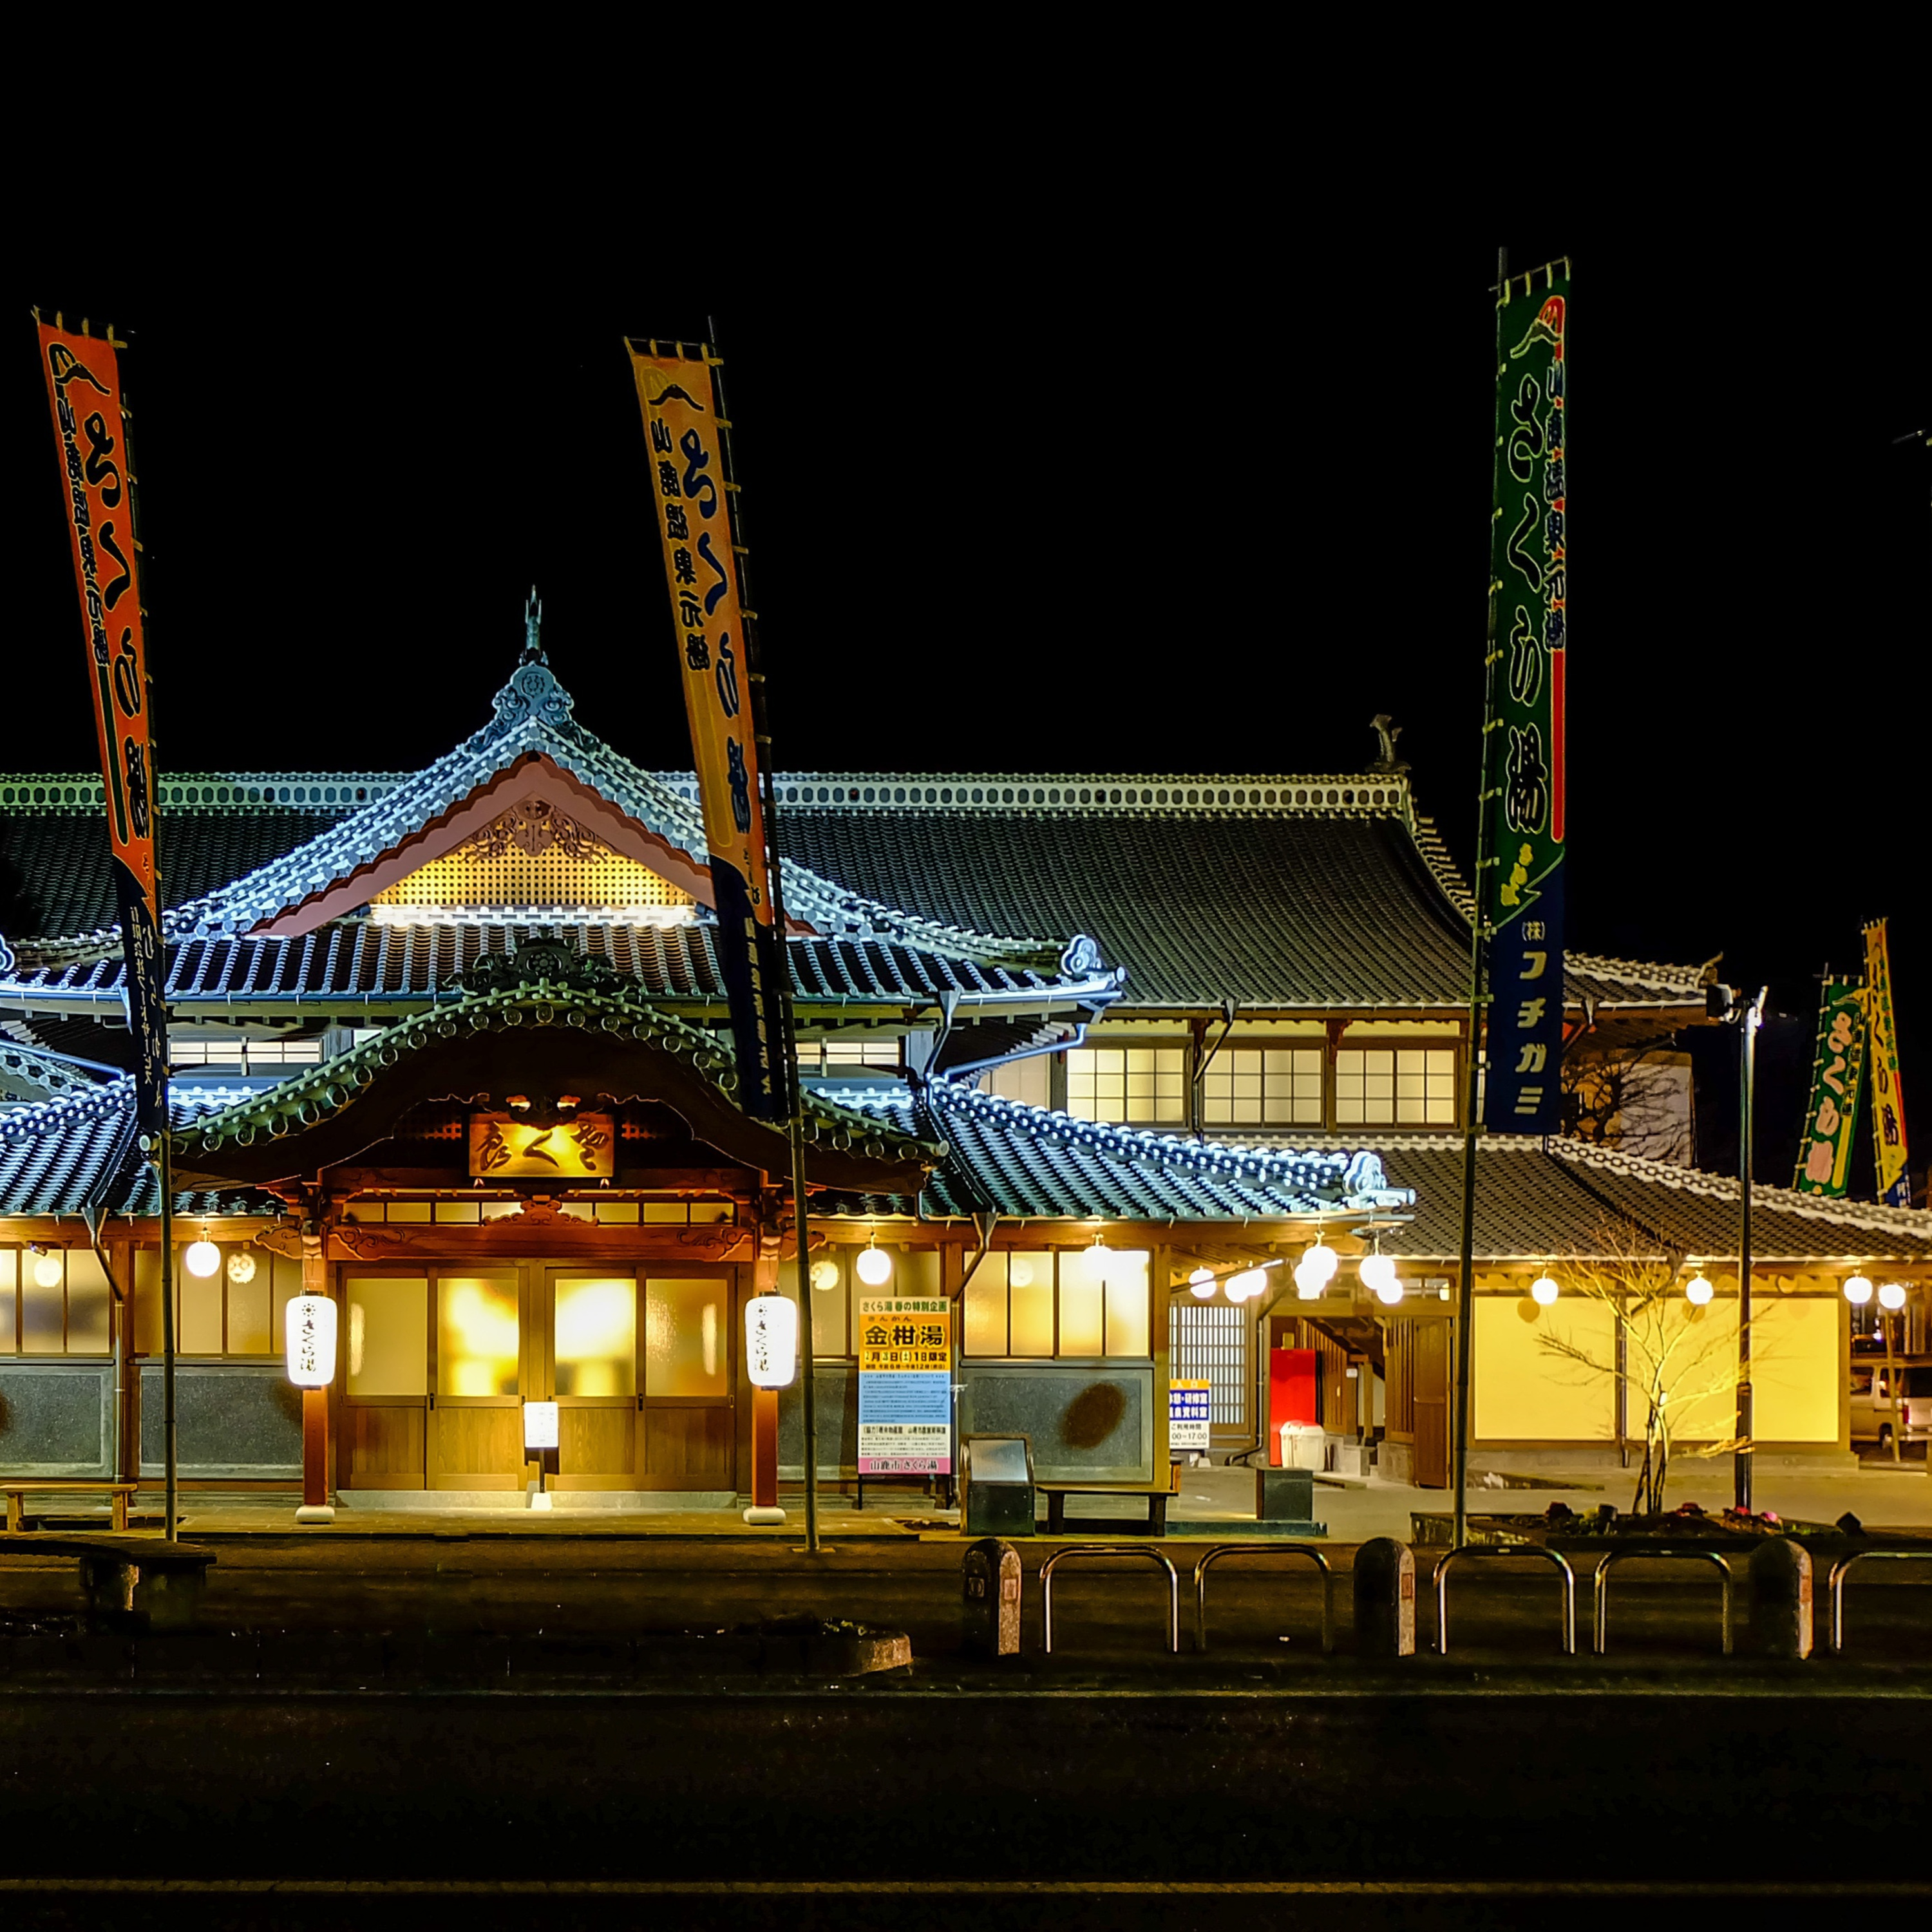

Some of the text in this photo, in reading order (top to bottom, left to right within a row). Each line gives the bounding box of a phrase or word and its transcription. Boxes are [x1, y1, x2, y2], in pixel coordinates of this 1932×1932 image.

[863, 1301, 893, 1312] さくら湯
[864, 1325, 943, 1346] 金柑湯
[301, 1320, 316, 1372] さくら湯
[870, 1460, 938, 1471] 山鹿市 さくら湯
